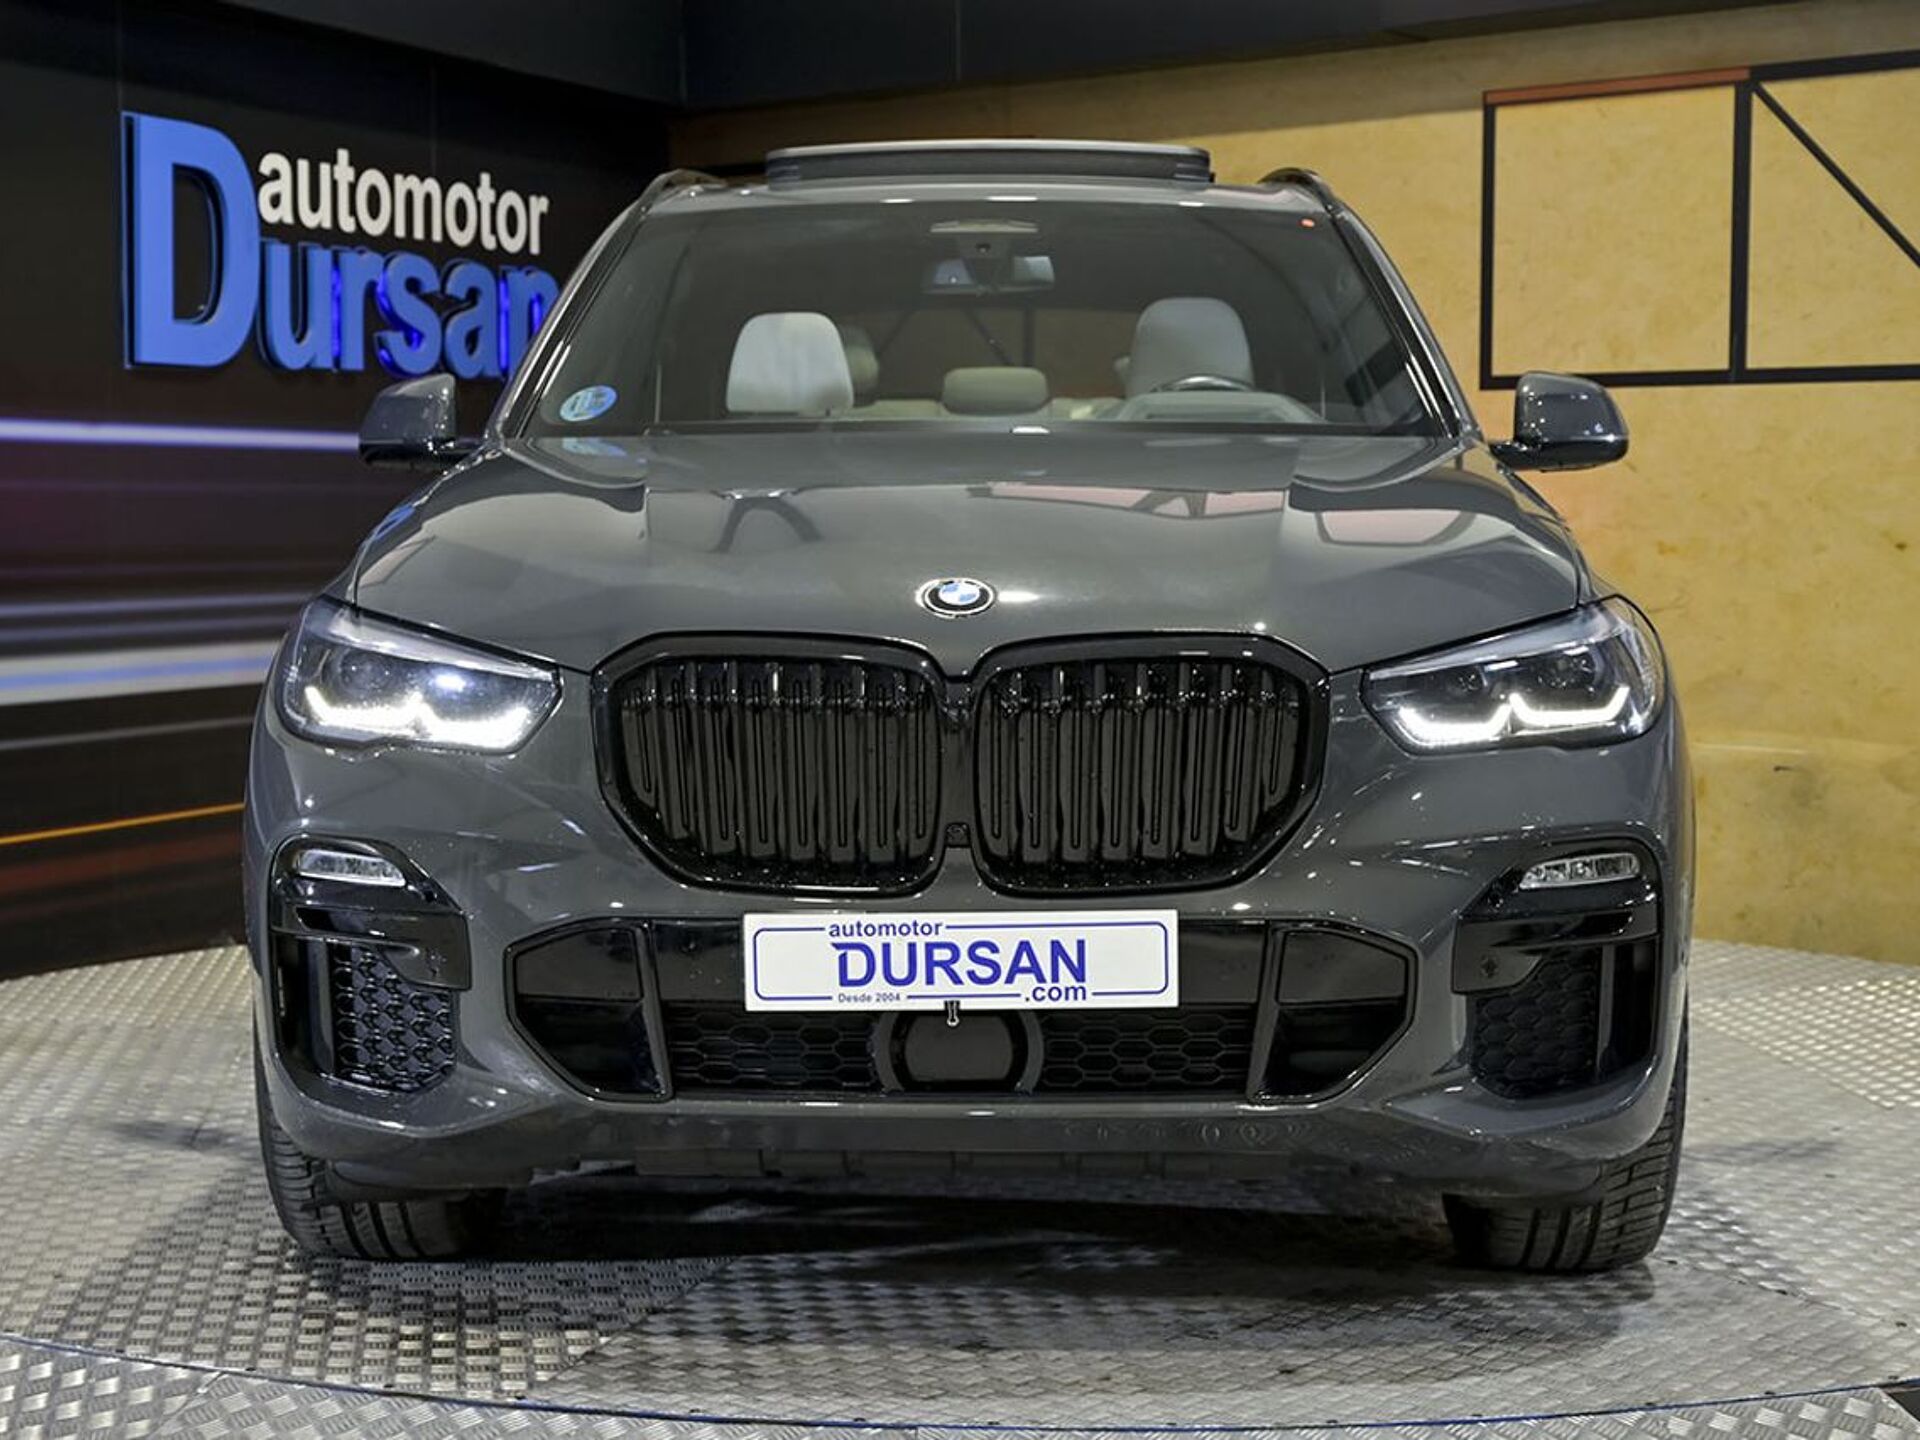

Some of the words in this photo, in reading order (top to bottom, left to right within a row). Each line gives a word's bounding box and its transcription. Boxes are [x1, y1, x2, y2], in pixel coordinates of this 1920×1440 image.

[258, 148, 549, 255] automotor
[828, 920, 943, 938] automotor
[831, 939, 1086, 987] DURSAN
[838, 992, 872, 1003] Desde
[876, 992, 901, 1002] 2004
[1024, 984, 1087, 1002] .com
